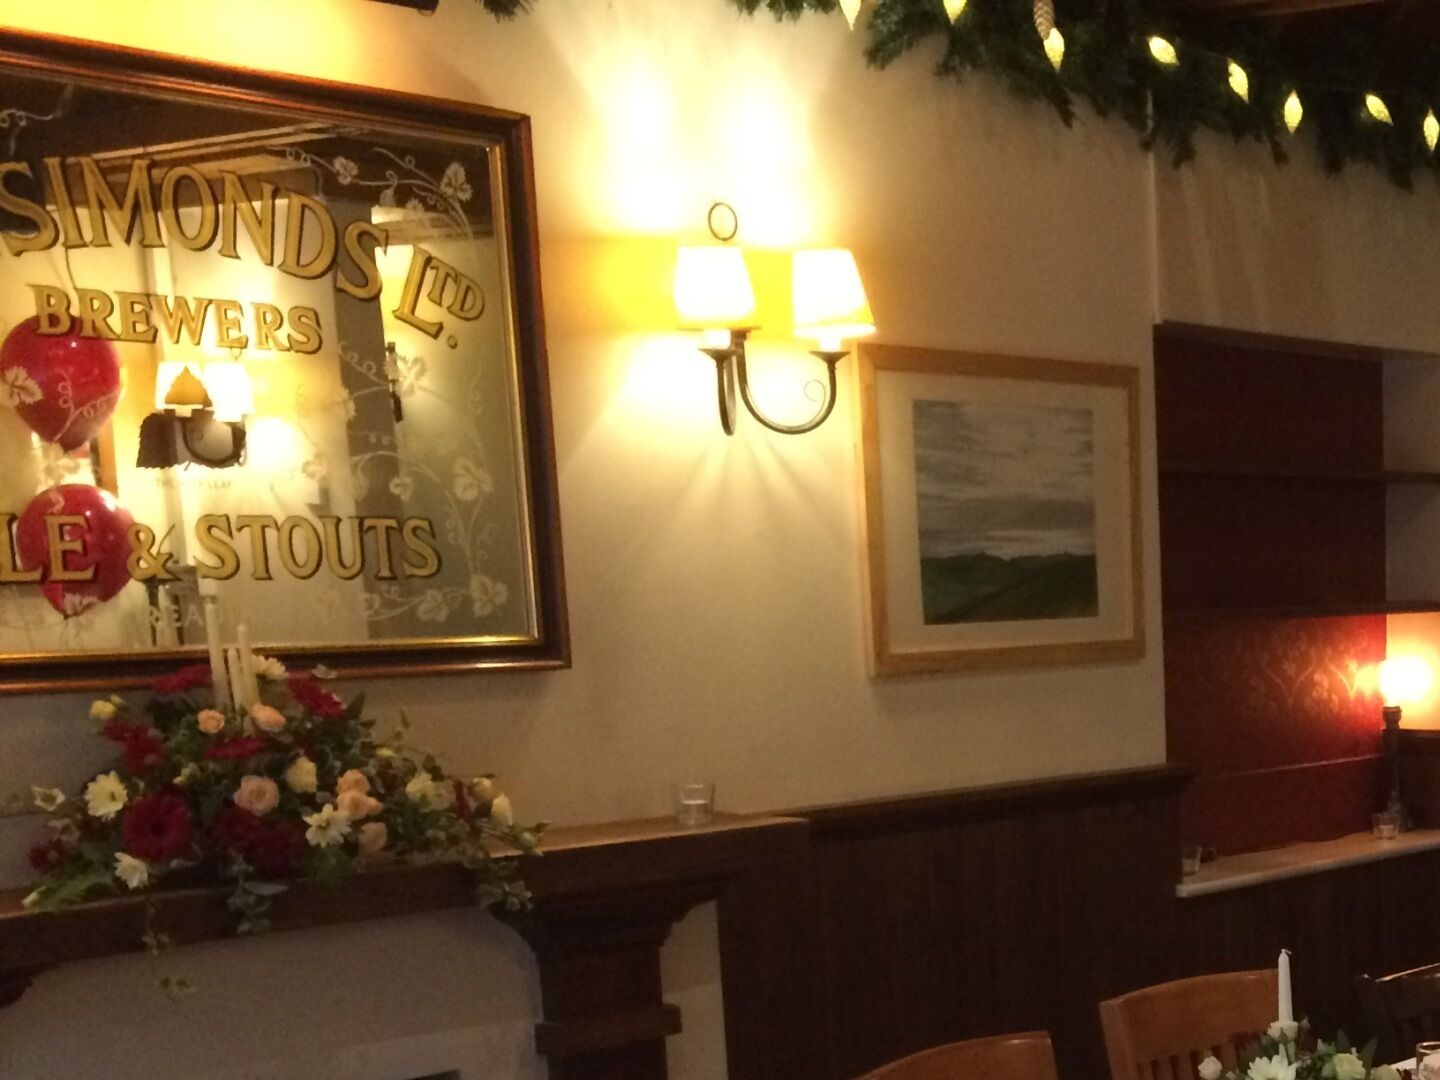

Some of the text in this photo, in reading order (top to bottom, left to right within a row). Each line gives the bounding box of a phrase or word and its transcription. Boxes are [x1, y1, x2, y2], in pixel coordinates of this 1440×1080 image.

[27, 284, 322, 354] BREWERS
[127, 522, 181, 582] &
[194, 513, 441, 580] STOUTS
